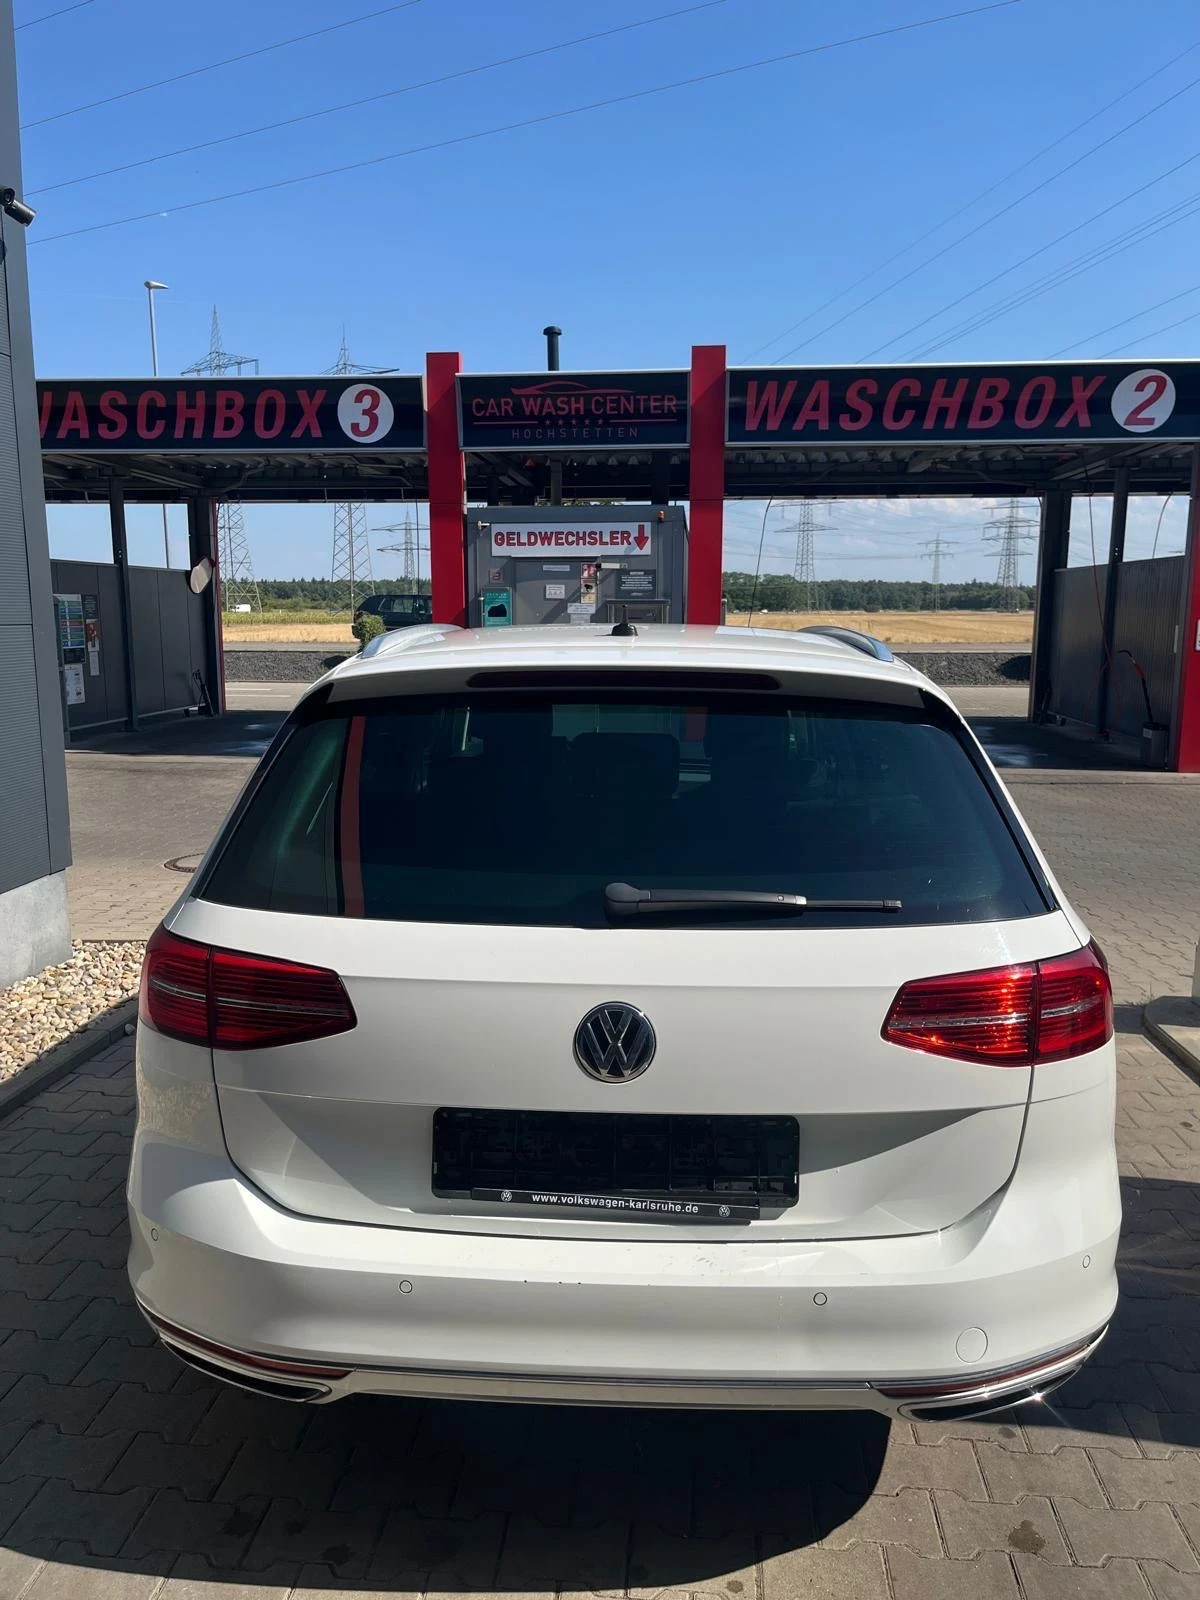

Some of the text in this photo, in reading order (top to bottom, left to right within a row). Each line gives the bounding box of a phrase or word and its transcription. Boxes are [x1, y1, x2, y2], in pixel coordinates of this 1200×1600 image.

[351, 388, 380, 438] 3
[472, 394, 678, 417] CAR WASH CENTER
[744, 375, 1168, 431] WASCHBOX 2
[511, 427, 638, 440] HOCHSTETTEN
[494, 530, 632, 547] GELDWECHSLER
[532, 1193, 699, 1214] www.volkswagen-karlsruhe.de
